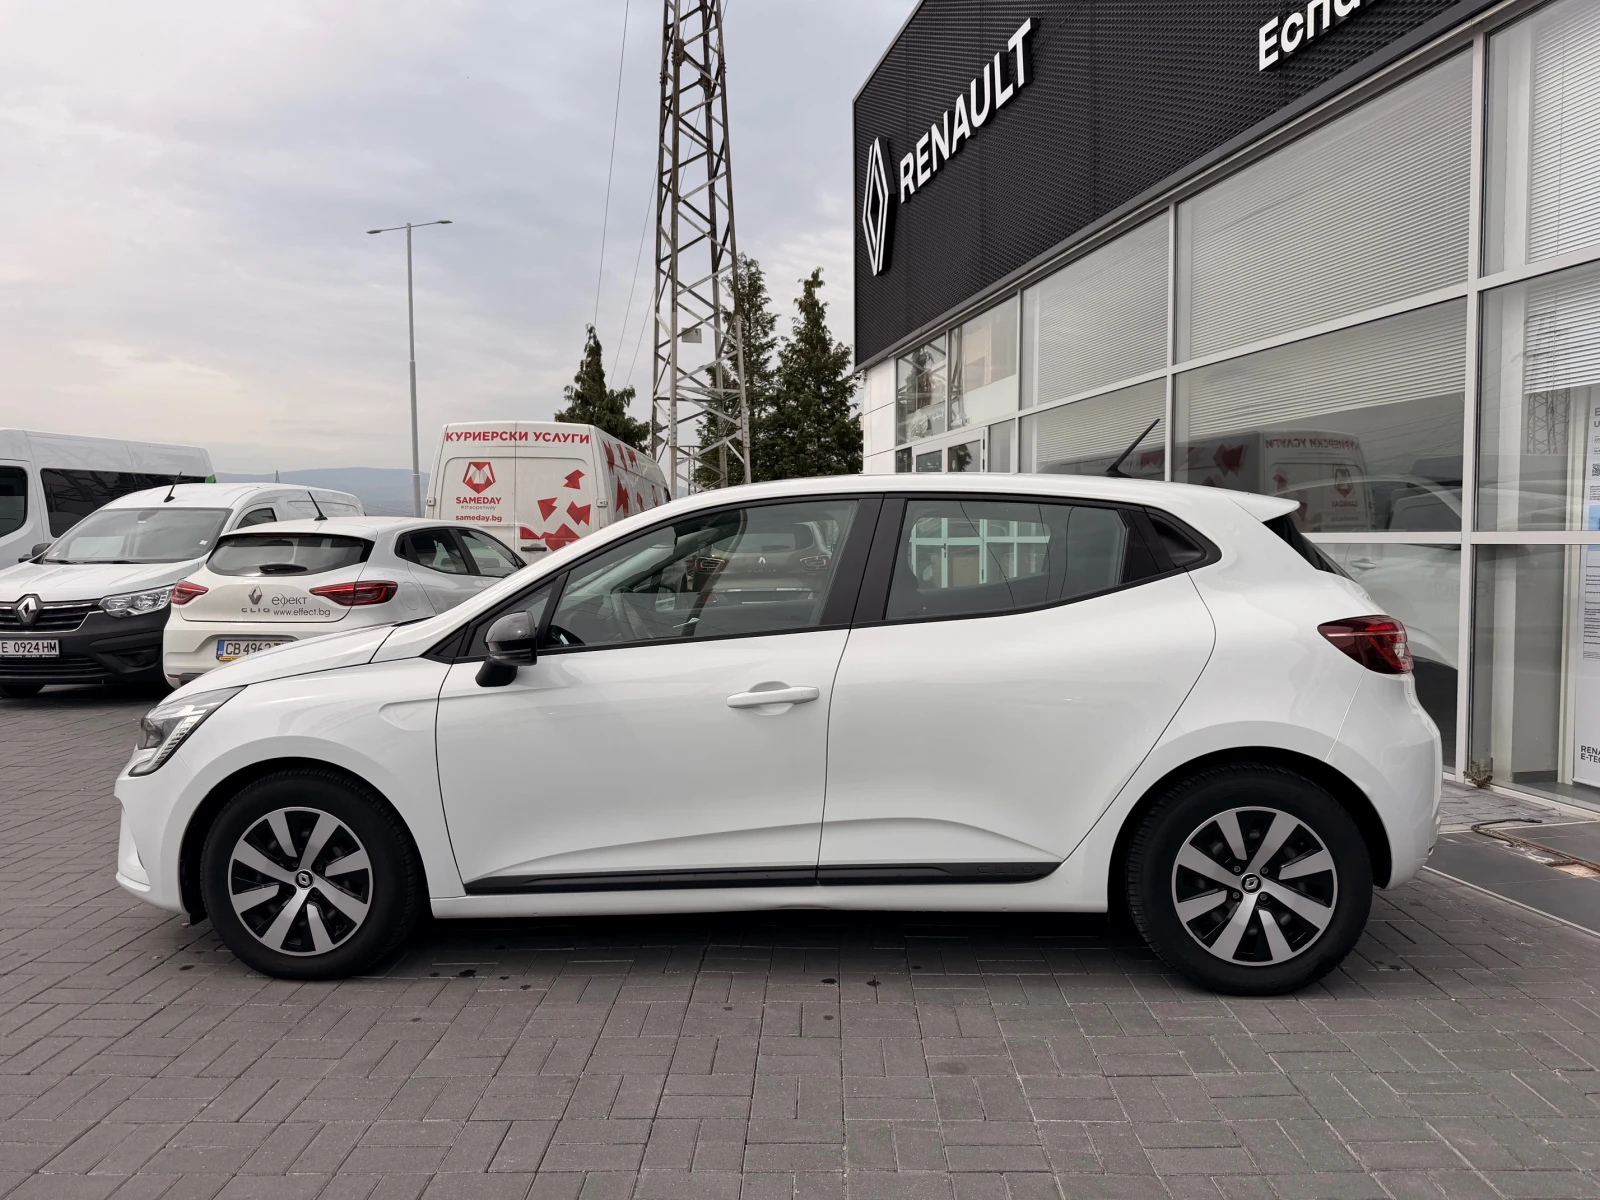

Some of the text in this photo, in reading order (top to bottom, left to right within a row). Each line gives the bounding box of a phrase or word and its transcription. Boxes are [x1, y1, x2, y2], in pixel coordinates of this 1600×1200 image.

[900, 17, 1031, 204] RENAULT
[445, 431, 590, 444] КУРИЕРСКИ УСЛУГИ
[456, 496, 502, 504] SAMEDAY
[455, 514, 503, 522] sameday.bg
[273, 607, 331, 617] www.effect.bg
[13, 641, 40, 653] 0924
[42, 641, 57, 653] HM
[225, 642, 241, 655] CB
